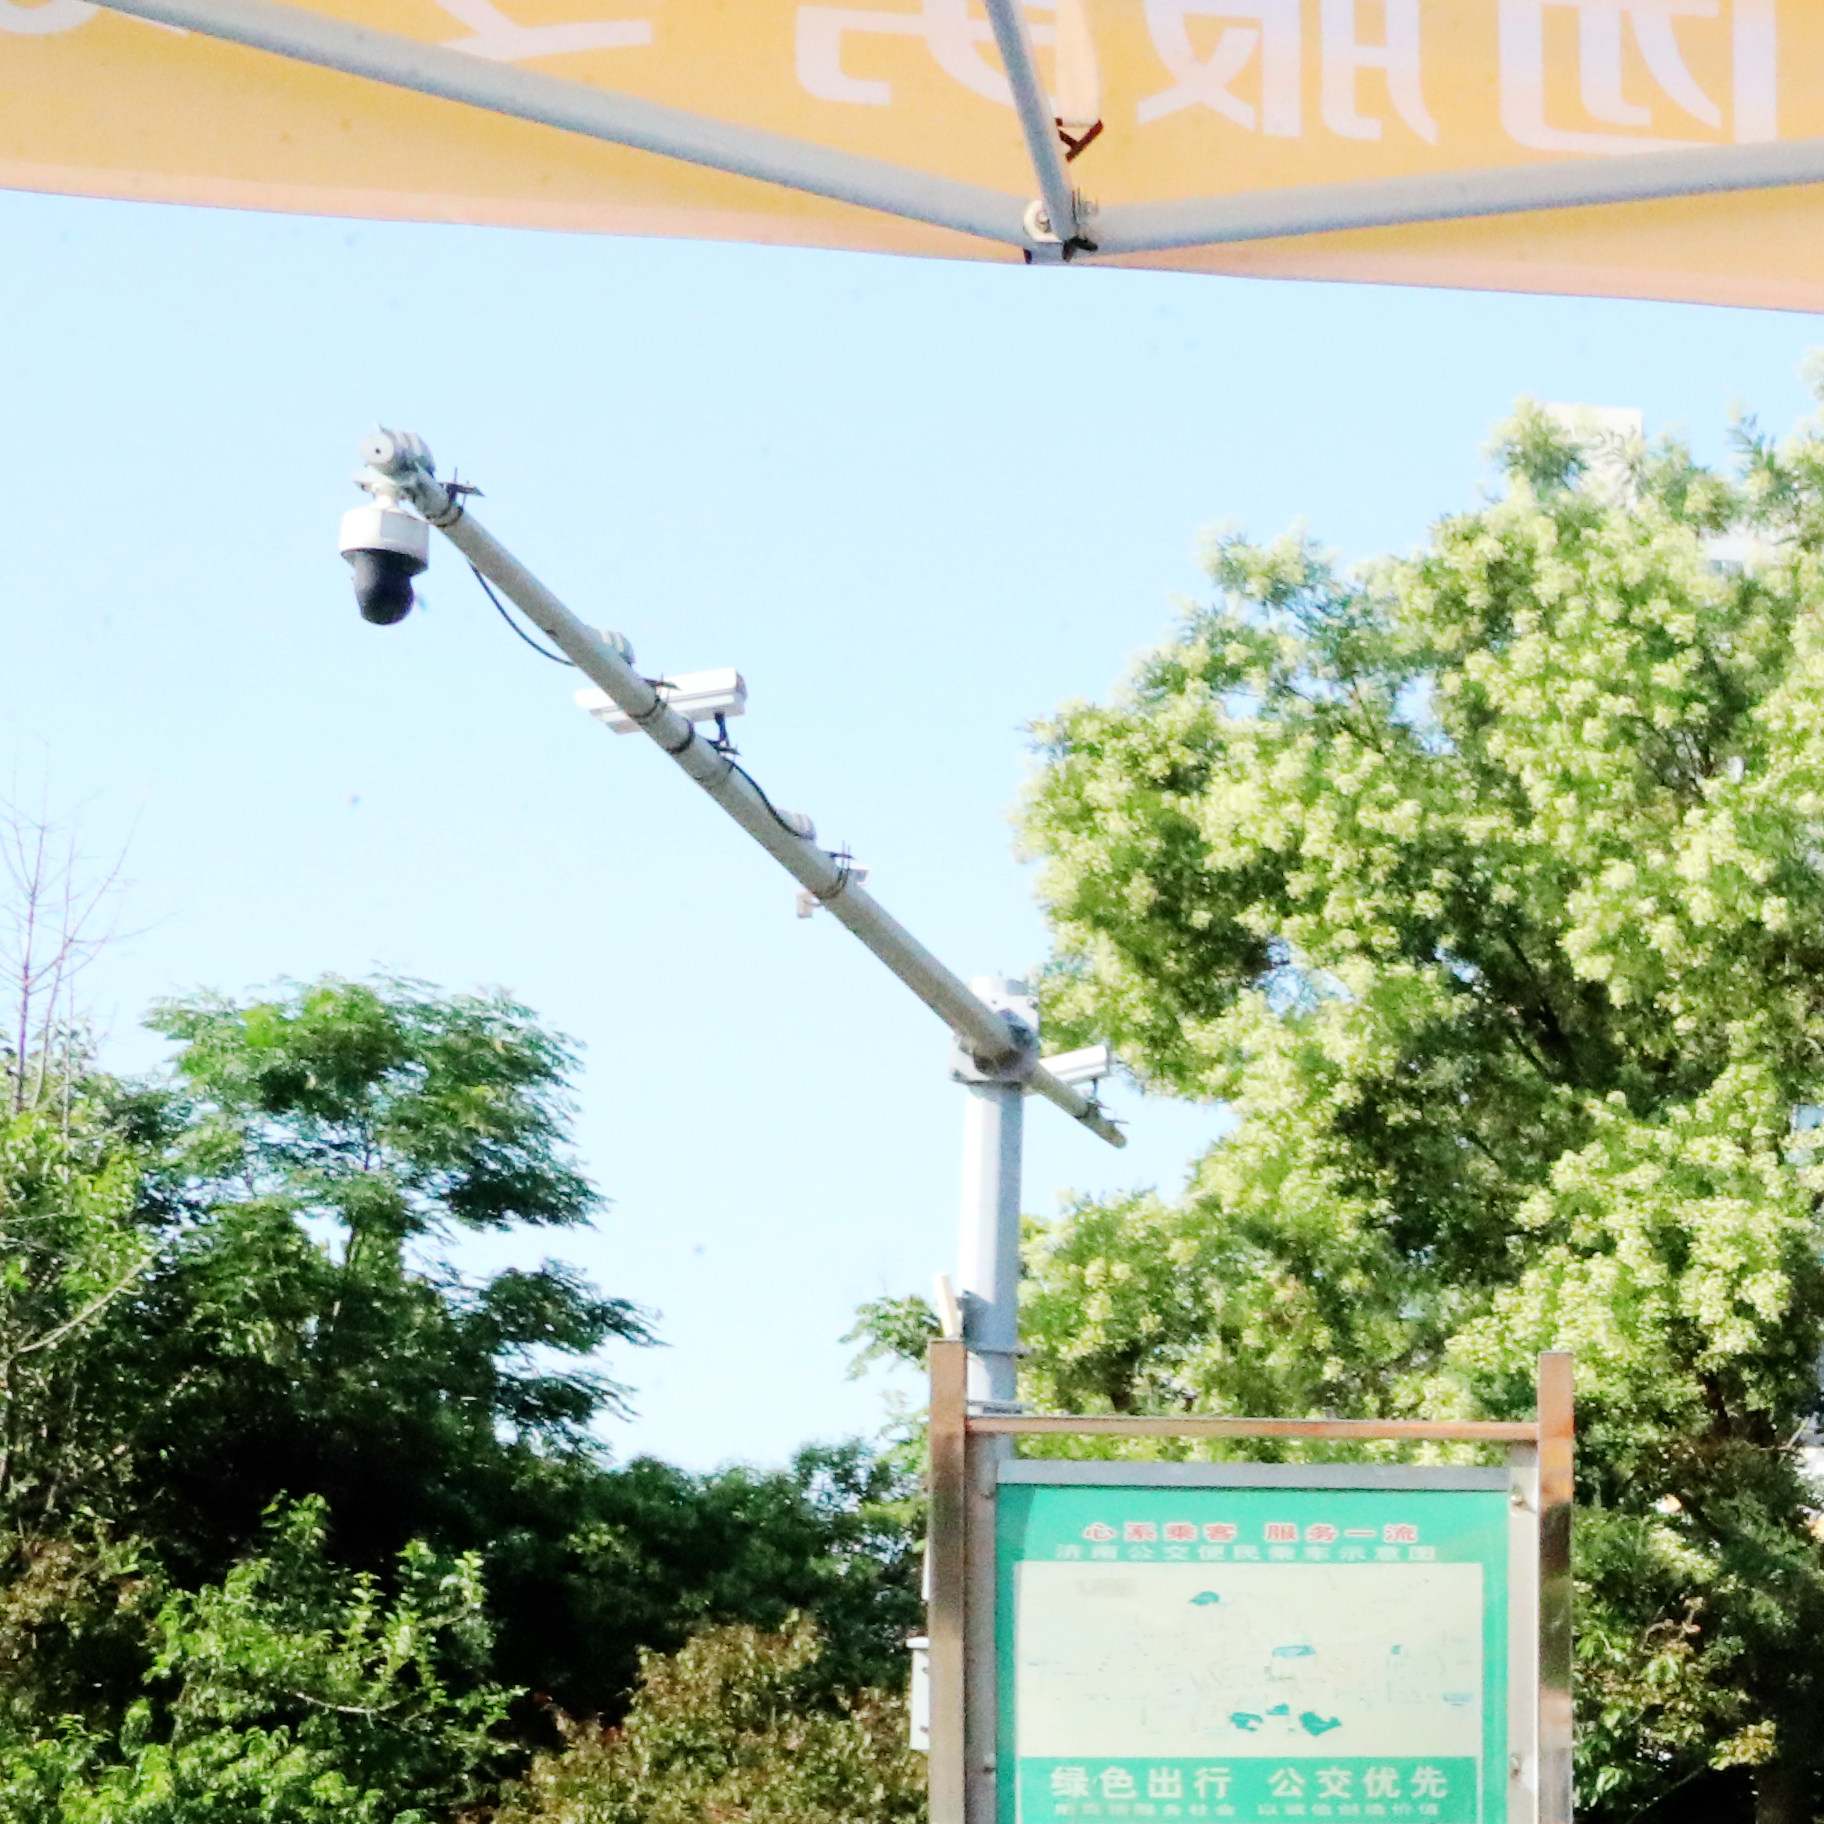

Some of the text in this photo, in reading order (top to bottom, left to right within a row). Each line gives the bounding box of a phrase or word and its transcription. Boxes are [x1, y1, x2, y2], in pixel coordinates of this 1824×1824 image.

[1081, 1521, 1420, 1544] 心系乘客 服务一流
[1050, 1765, 1449, 1800] 绿色出行 公交优先
